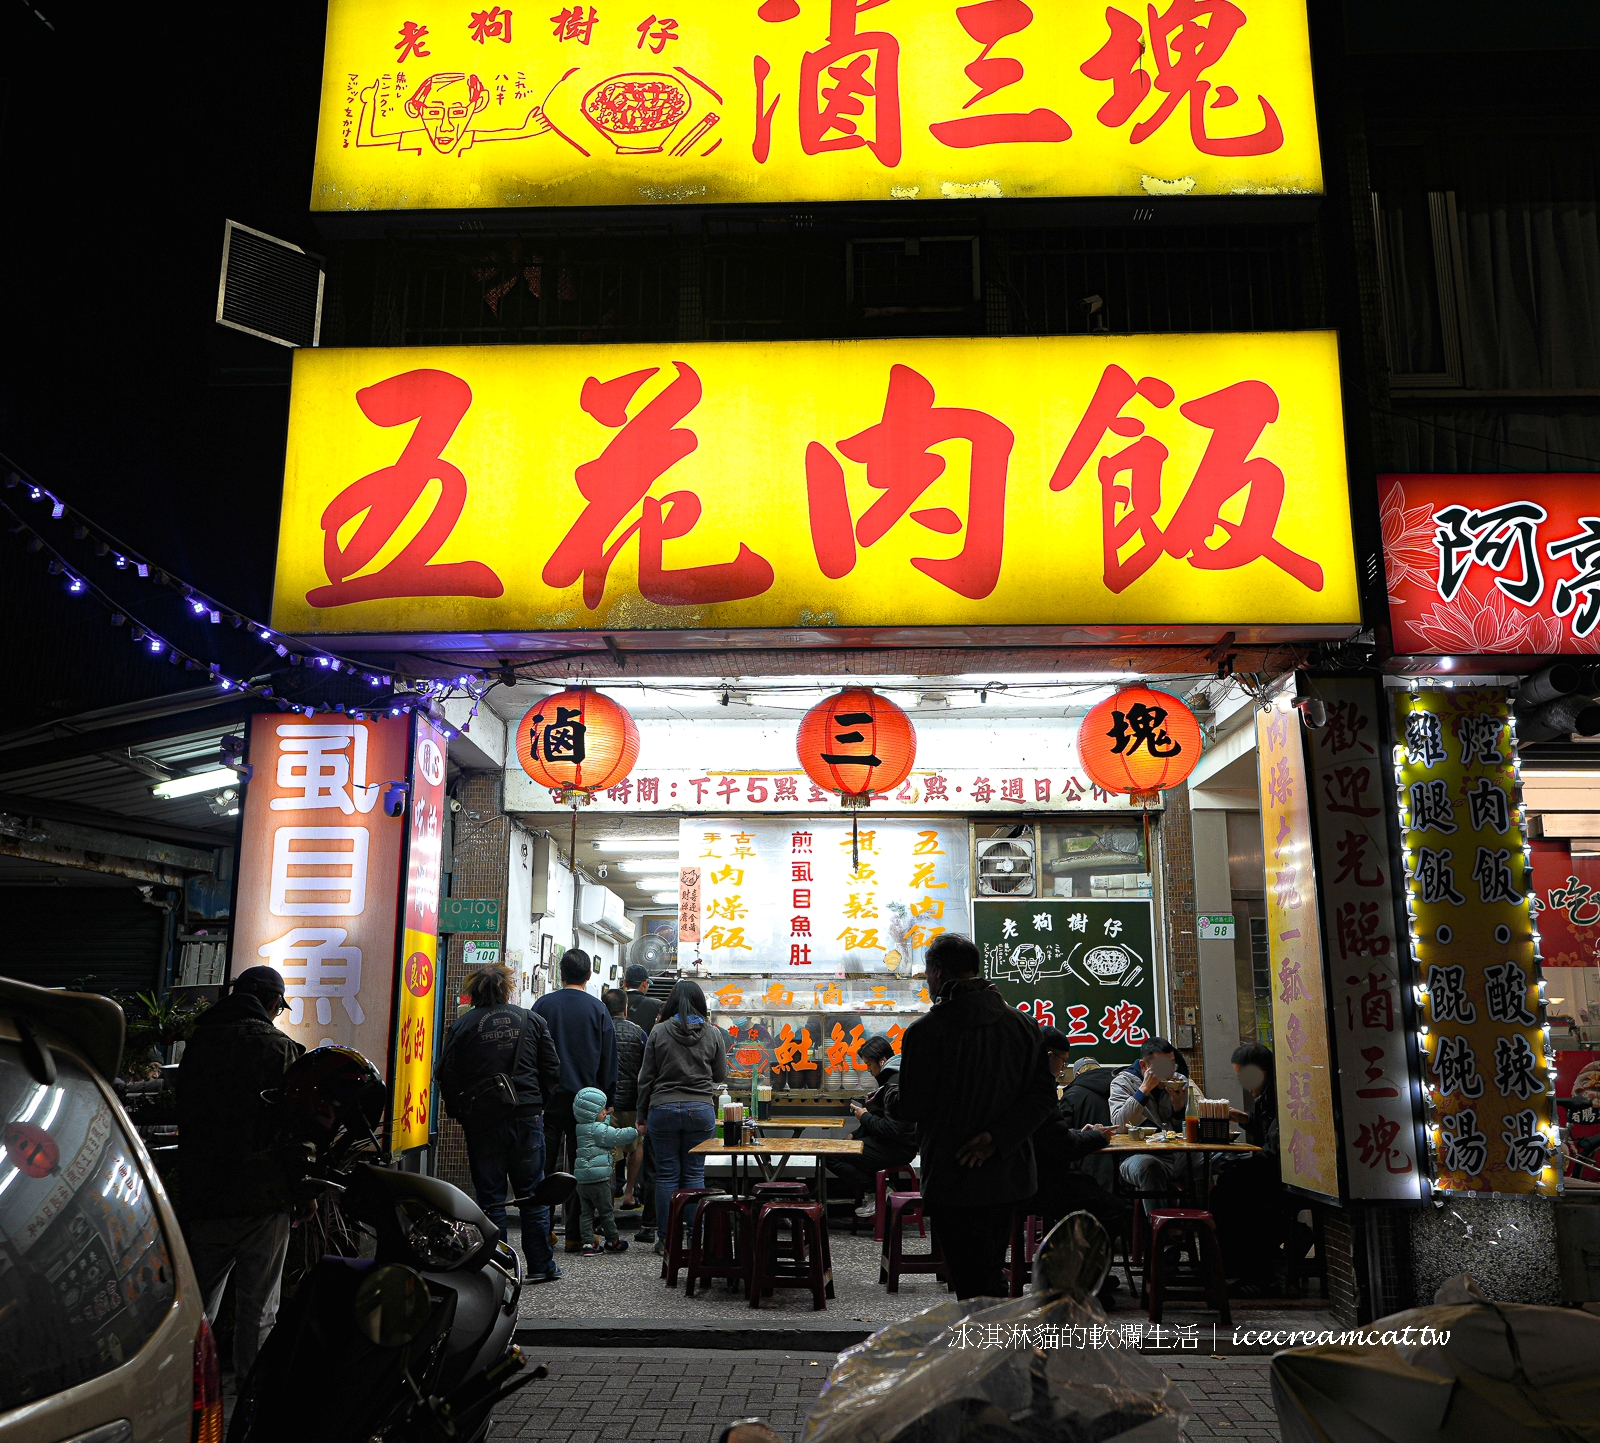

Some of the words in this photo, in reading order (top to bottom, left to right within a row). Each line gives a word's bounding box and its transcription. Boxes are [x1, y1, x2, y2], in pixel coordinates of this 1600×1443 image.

[395, 6, 679, 63] 老狗樹仔
[515, 71, 533, 100] これが
[753, 0, 1284, 168] 滷三塊
[305, 361, 1324, 609] 五花肉飯
[530, 706, 587, 765] 滷
[820, 712, 882, 767] 三
[1106, 702, 1182, 758] 塊
[699, 832, 722, 859] 手工
[730, 831, 756, 859] 古早
[258, 723, 380, 1047] 虱目魚
[703, 864, 753, 951] 肉燥飯
[789, 831, 813, 966] 煎虱目魚肚
[836, 830, 886, 951] 旗魚鬆飯
[903, 830, 949, 950] 五花肉飯
[1002, 912, 1123, 939] 老狗樹仔
[1214, 926, 1227, 936] 98
[1320, 700, 1413, 1175] 歡迎光臨滷三塊
[410, 956, 429, 989] 良心
[476, 951, 496, 961] 100
[401, 1015, 426, 1065] 吃的
[401, 1083, 427, 1134] 安心
